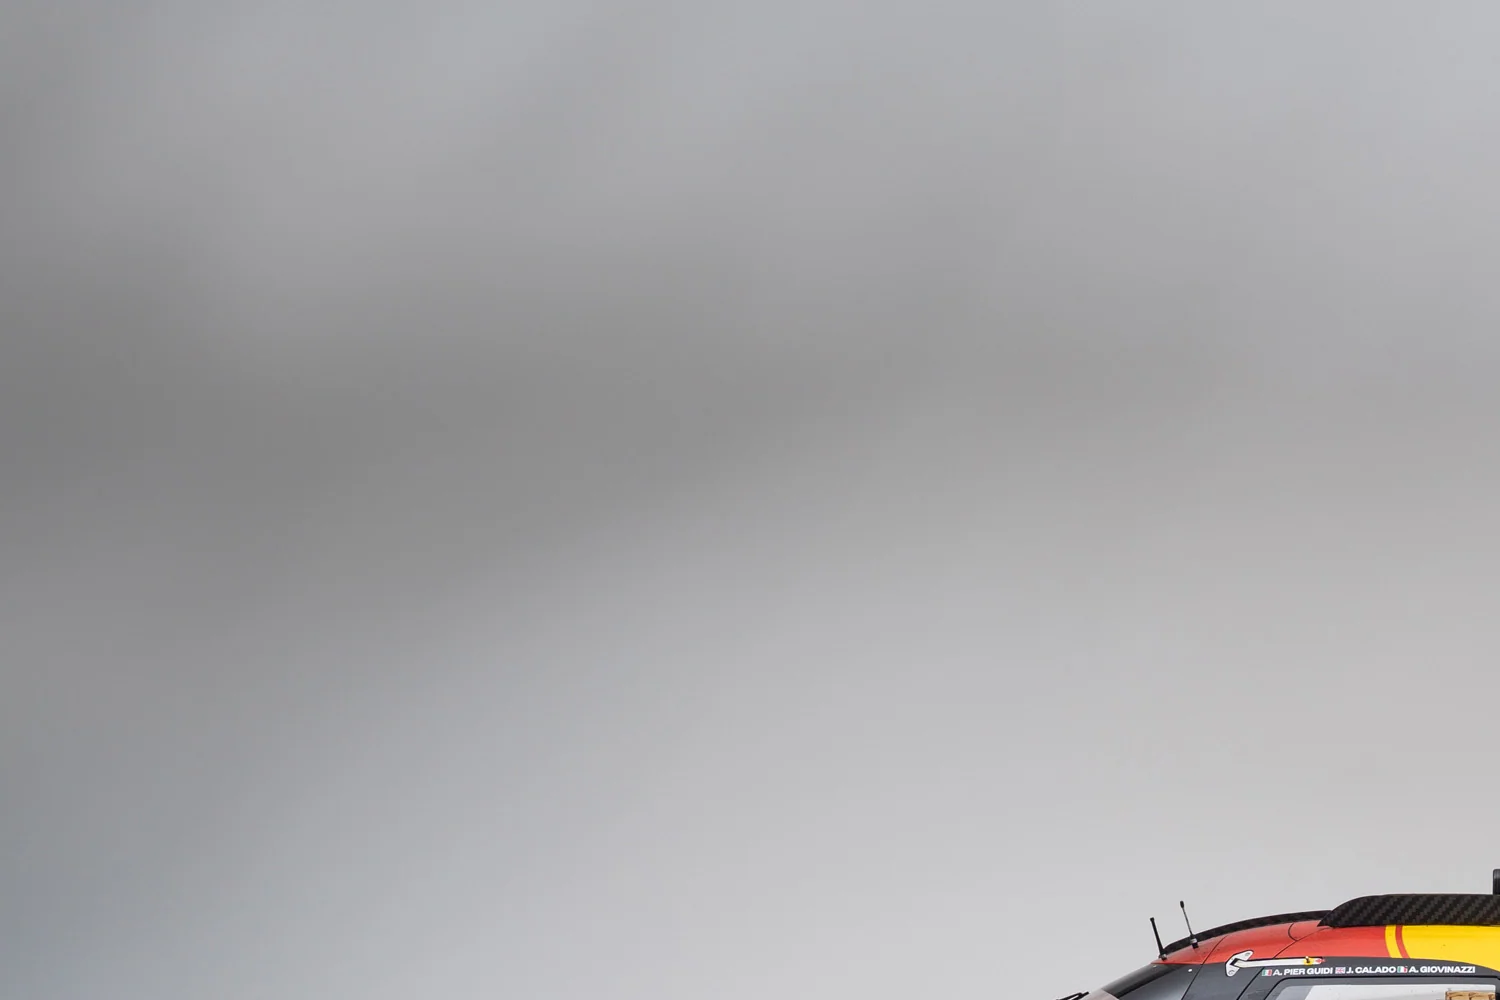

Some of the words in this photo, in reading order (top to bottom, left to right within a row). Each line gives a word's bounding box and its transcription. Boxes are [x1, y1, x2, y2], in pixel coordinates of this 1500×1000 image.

[1273, 968, 1283, 976] A.
[1284, 968, 1306, 976] PIER
[1307, 967, 1333, 975] GUIDI
[1355, 966, 1396, 974] CALADO
[1420, 965, 1476, 974] GIOVINAZZI
